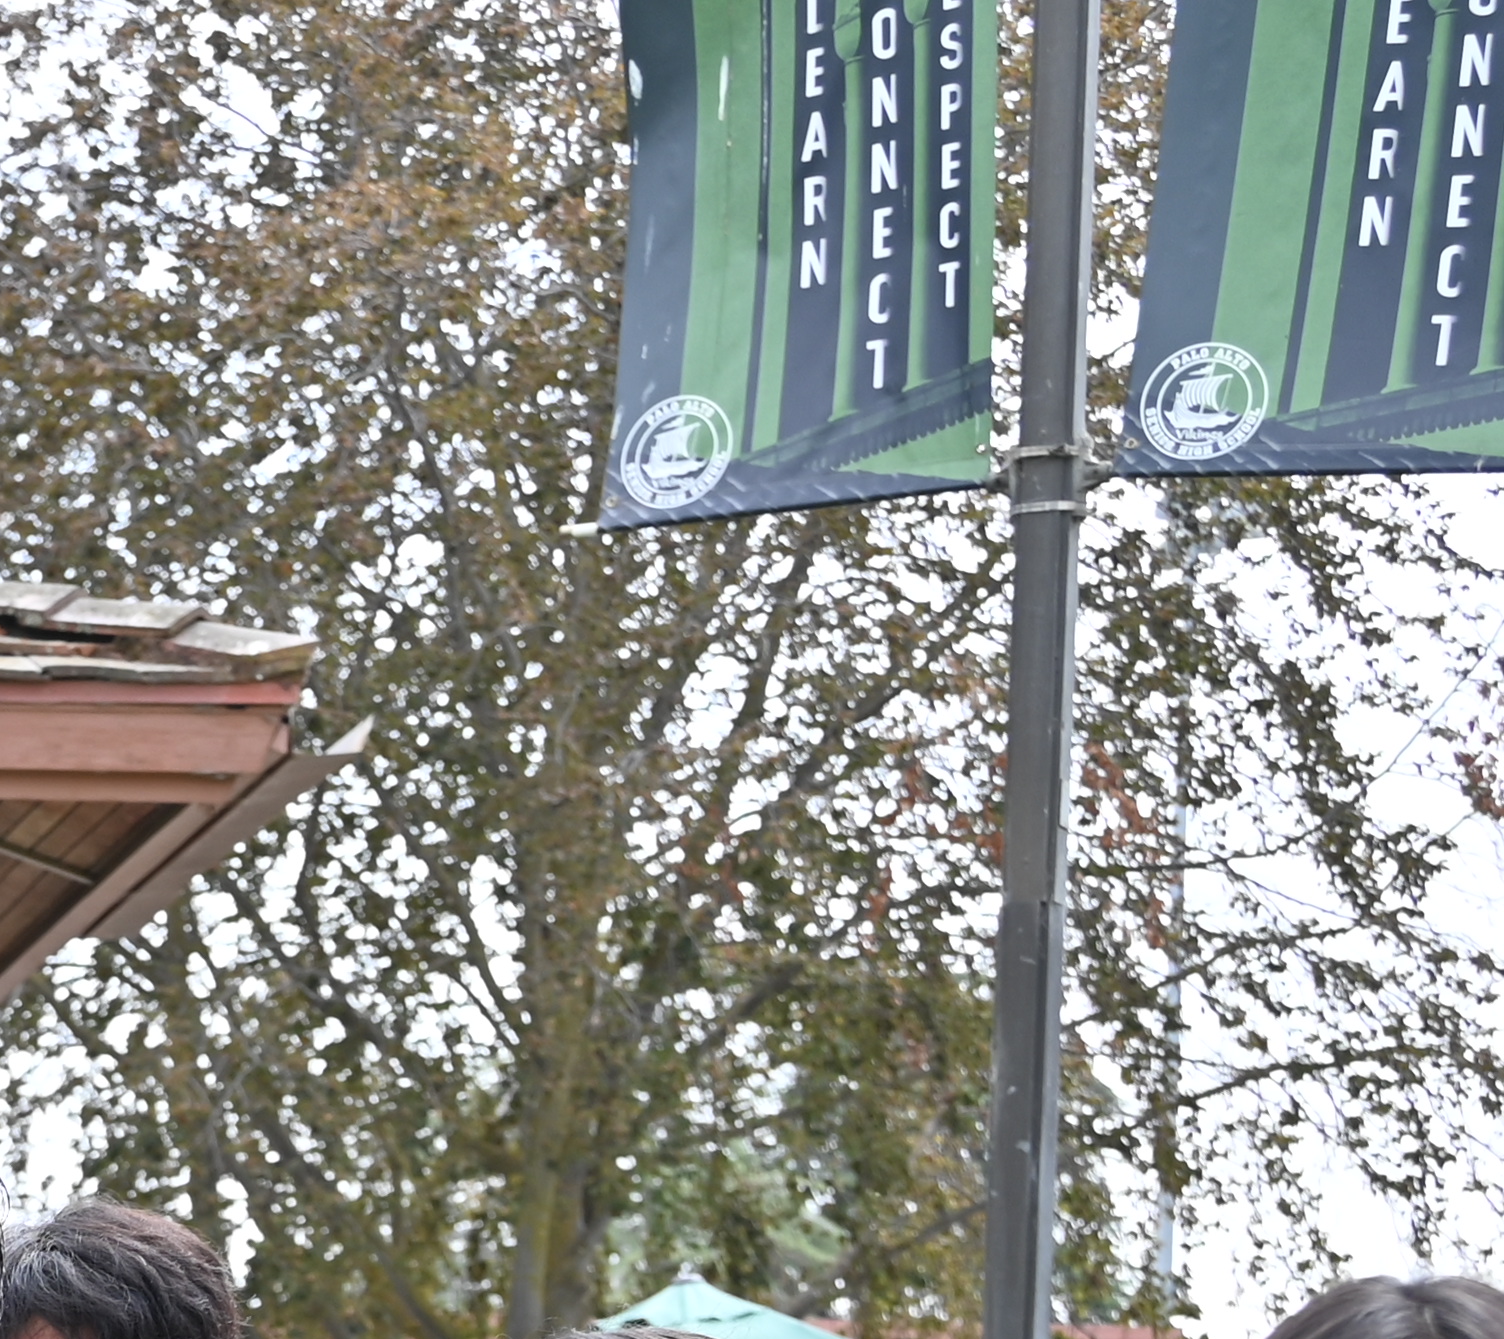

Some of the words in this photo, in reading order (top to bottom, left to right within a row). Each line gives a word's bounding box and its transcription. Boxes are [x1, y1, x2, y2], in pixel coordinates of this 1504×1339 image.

[864, 7, 898, 390] ONNECT
[937, 0, 964, 309] SPECT
[1358, 0, 1413, 248] EARN
[1429, 0, 1498, 367] NNECT
[1169, 347, 1210, 371] PALO
[1214, 347, 1251, 371] ALTO
